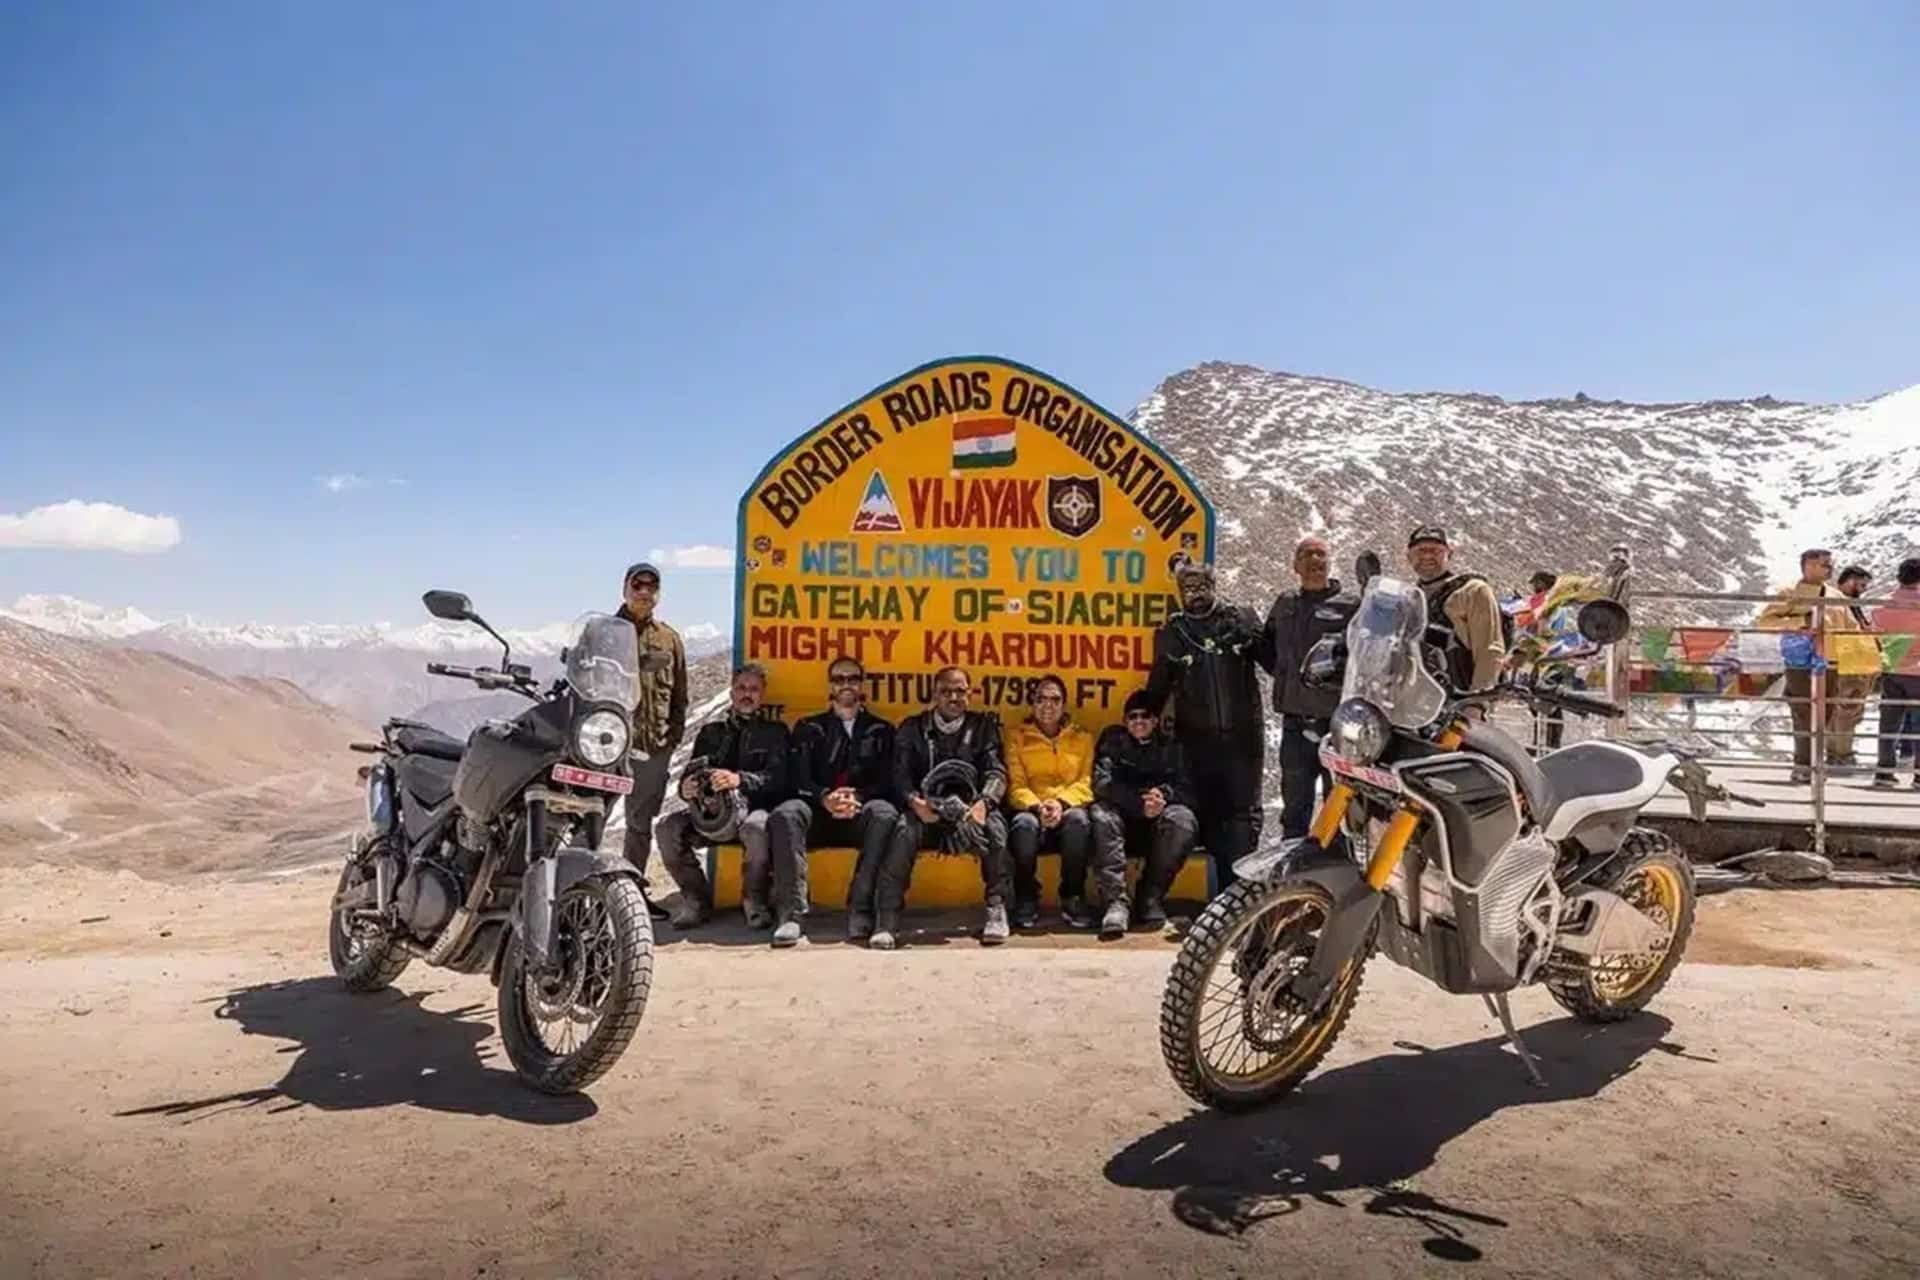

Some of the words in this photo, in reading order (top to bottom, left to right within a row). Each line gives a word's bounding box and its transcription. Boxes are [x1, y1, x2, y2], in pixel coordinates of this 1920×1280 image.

[758, 412, 884, 531] BORDER
[882, 370, 992, 434] ROADS
[1001, 376, 1197, 543] ORGANISATION
[908, 477, 1043, 530] VIJAYAK
[801, 541, 990, 580] WELCOMES
[1011, 546, 1079, 582] YOU
[1102, 549, 1146, 584] TO
[751, 583, 931, 622] GATEWAY
[953, 588, 1004, 623] OF
[749, 626, 901, 663] MIGHTY
[866, 672, 936, 704] TITU
[1076, 679, 1117, 710] FT
